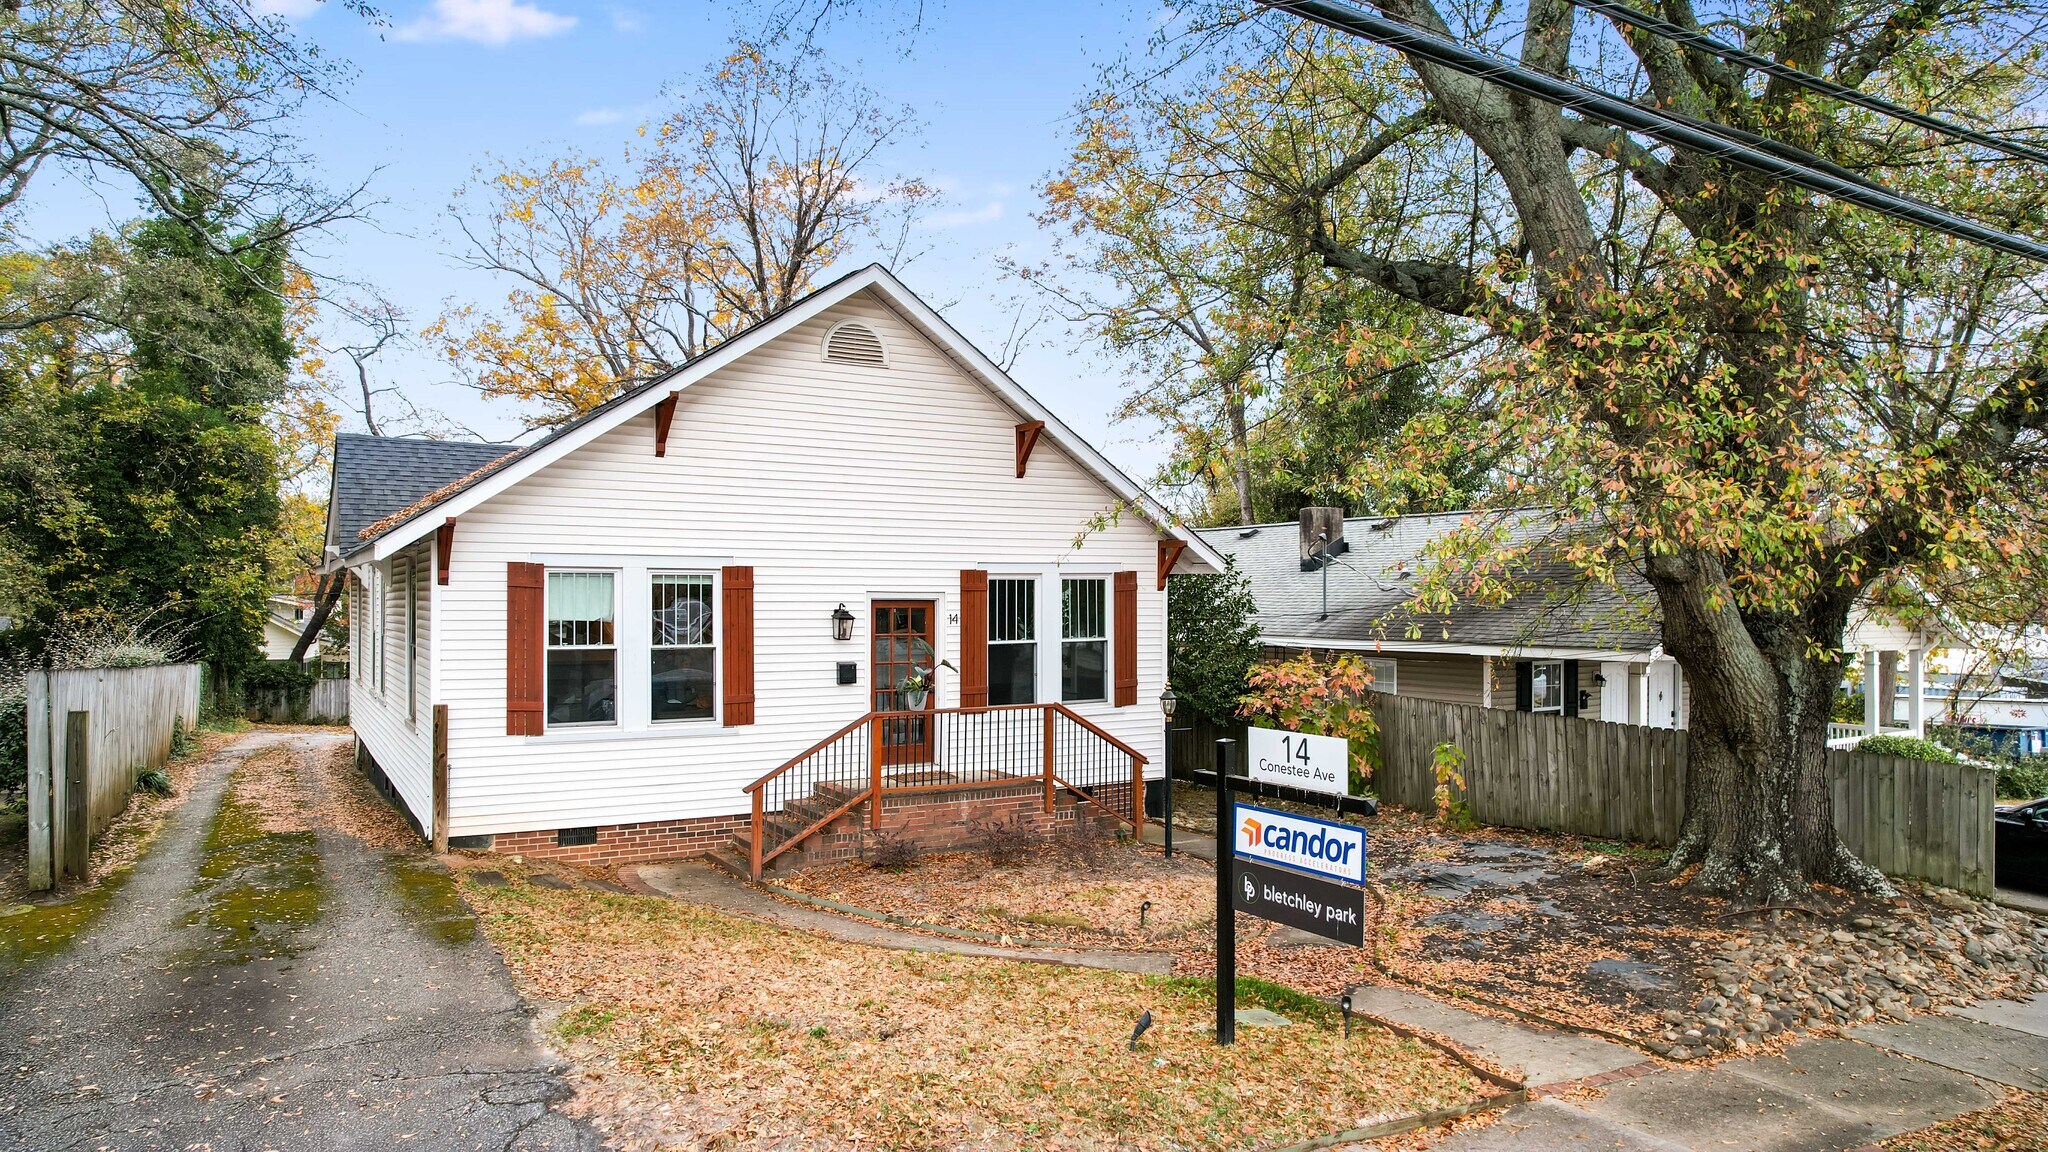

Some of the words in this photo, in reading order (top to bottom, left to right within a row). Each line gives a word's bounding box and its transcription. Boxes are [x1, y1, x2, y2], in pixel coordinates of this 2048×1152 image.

[949, 614, 958, 625] 14
[1282, 735, 1311, 766] 14
[1259, 758, 1310, 778] Conestee
[1313, 767, 1335, 783] Ave
[1263, 824, 1356, 865] candor
[1264, 849, 1296, 862] PROGRESS
[1300, 858, 1351, 876] ACCELERATORS
[1263, 885, 1322, 919] bletchley
[1326, 907, 1357, 925] park
